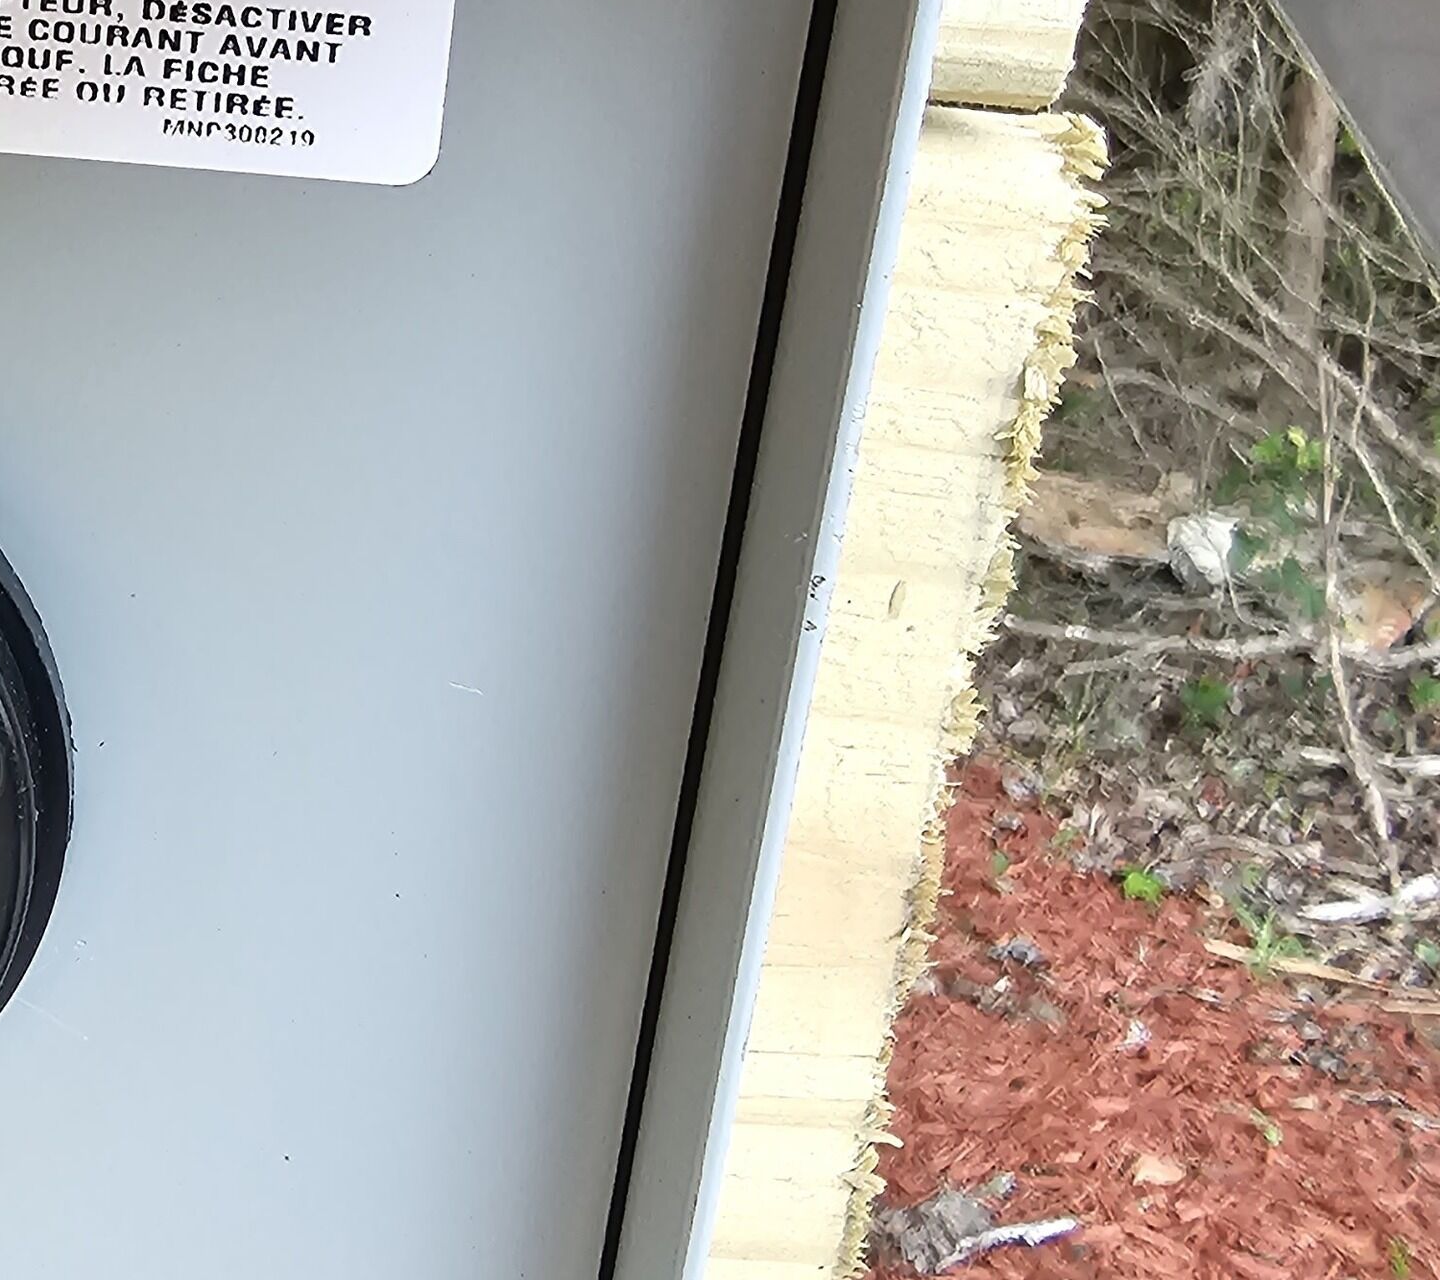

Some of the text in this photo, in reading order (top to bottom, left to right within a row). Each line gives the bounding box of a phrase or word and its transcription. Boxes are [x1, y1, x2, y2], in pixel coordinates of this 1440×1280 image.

[27, 17, 207, 55] COURANT
[217, 32, 344, 65] AVANT
[102, 52, 147, 79] LA
[161, 57, 270, 90] FICHE
[74, 79, 127, 105] OU
[142, 85, 305, 121] RETIRÉE.
